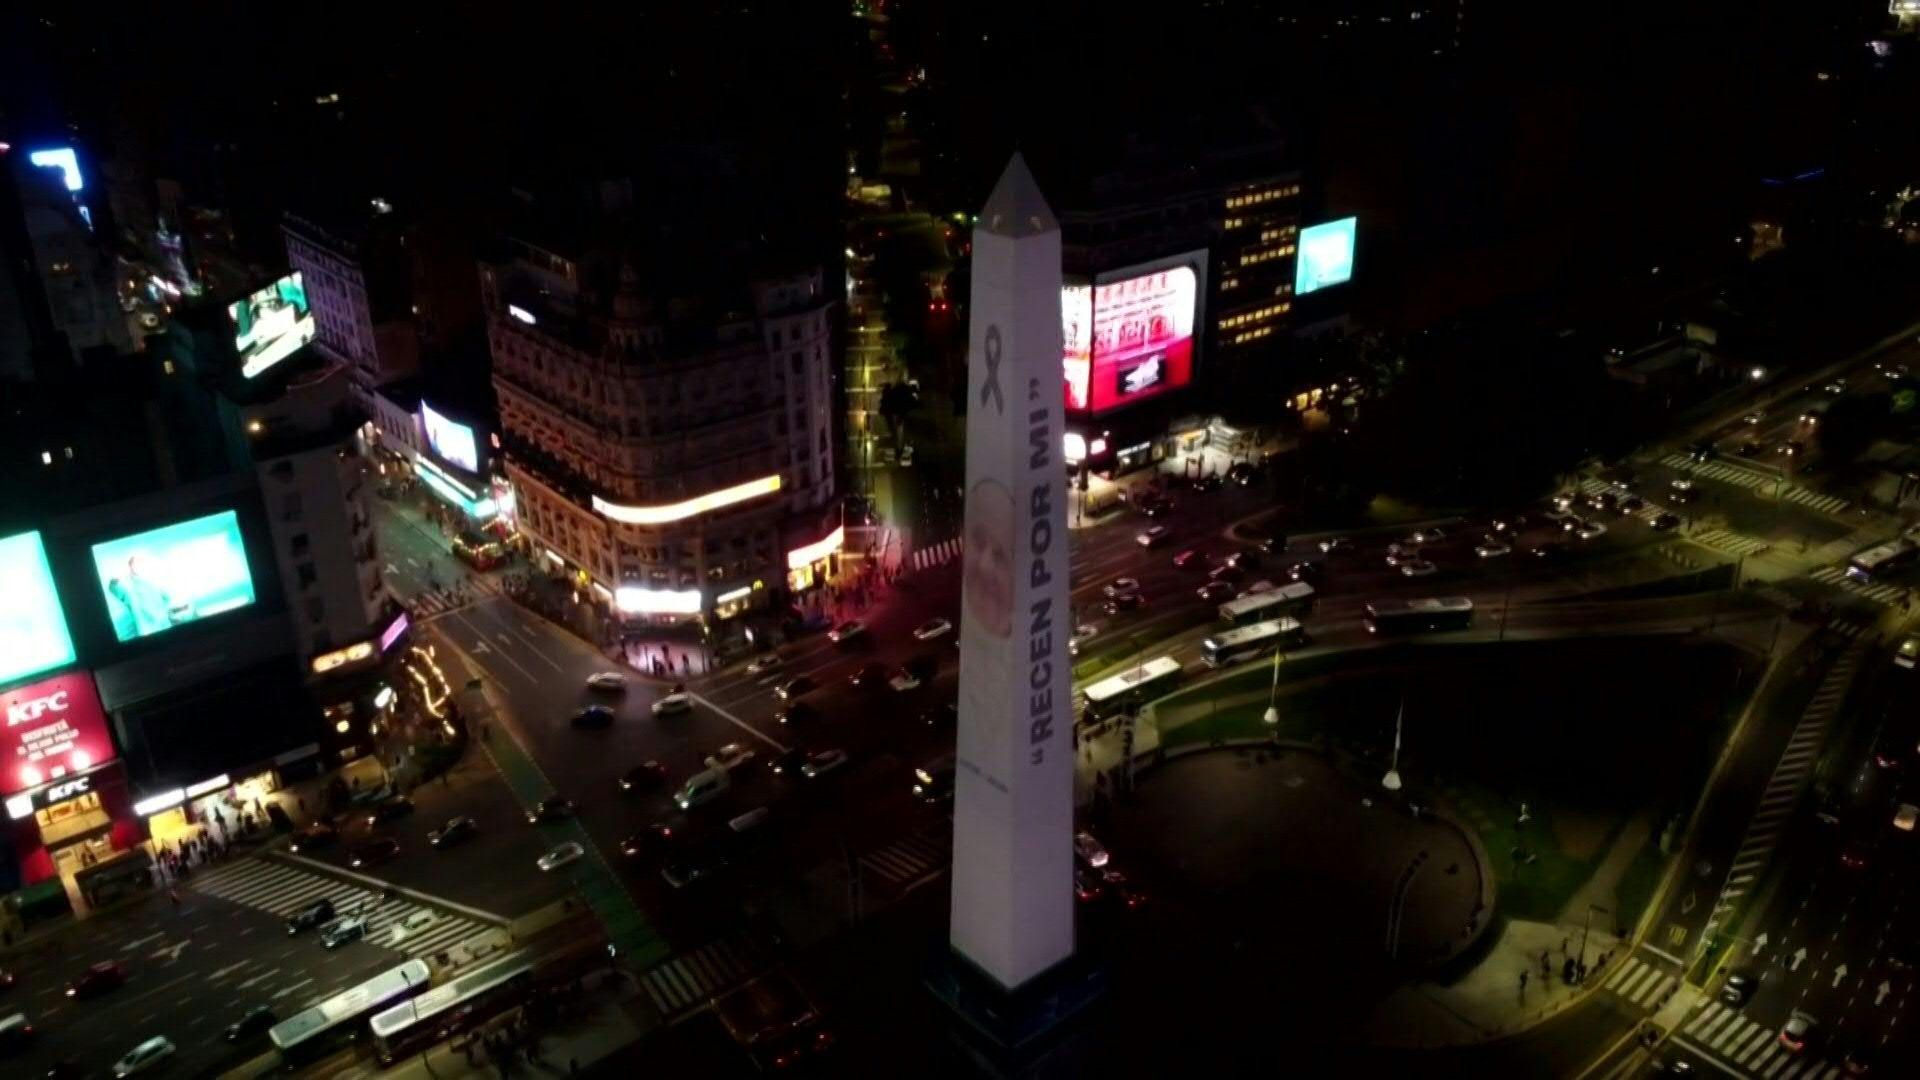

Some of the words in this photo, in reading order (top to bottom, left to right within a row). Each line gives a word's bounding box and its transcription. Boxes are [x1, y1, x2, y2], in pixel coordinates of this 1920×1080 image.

[1030, 482, 1052, 588] POR
[7, 690, 69, 726] KFC
[48, 776, 90, 802] KFC
